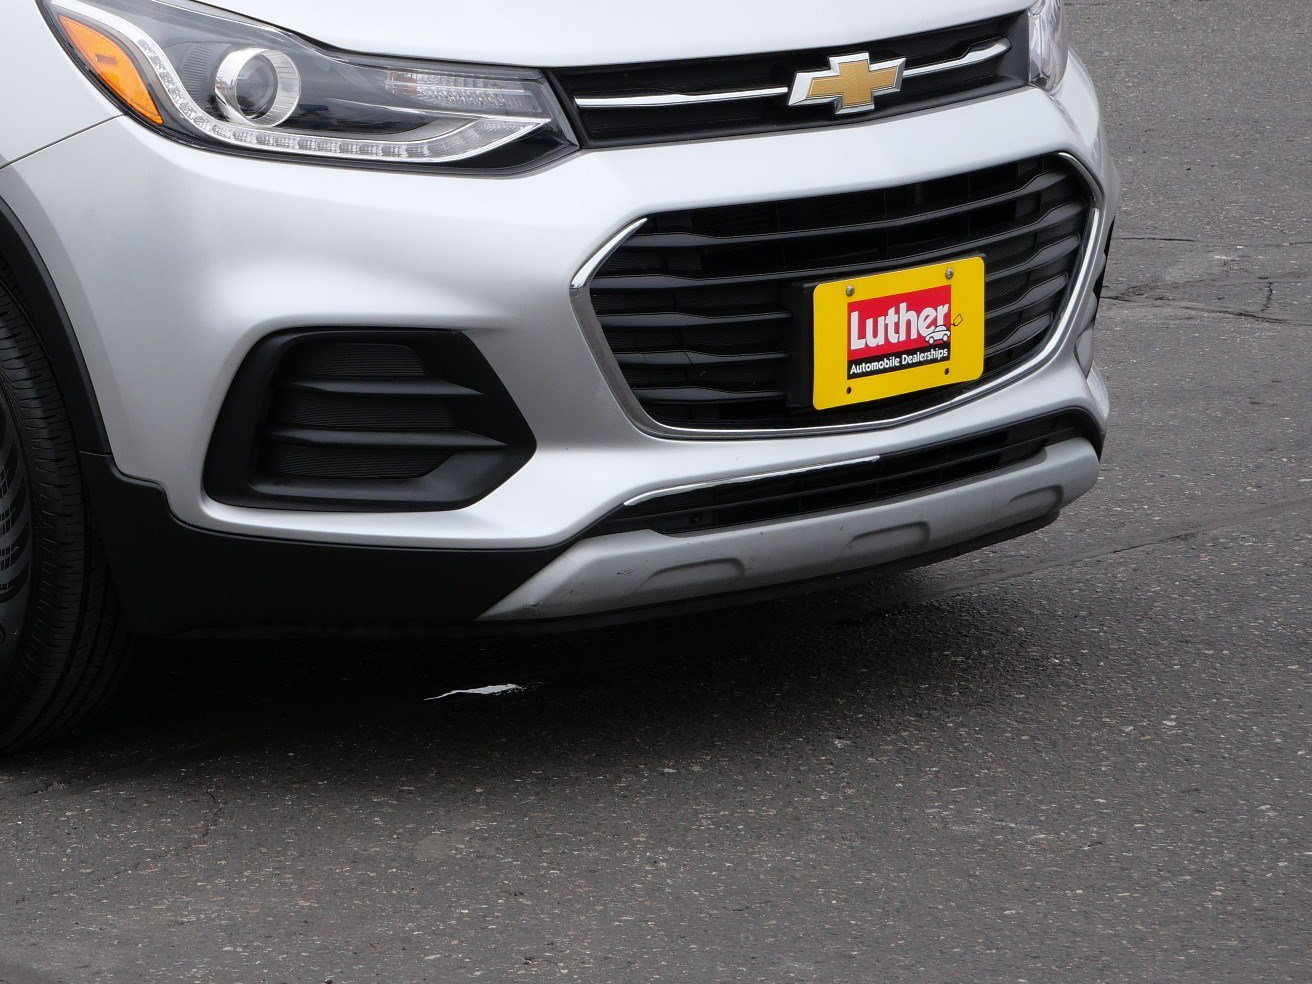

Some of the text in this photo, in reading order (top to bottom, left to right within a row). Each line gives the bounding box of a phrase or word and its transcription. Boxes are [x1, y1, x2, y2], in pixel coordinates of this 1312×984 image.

[850, 301, 950, 350] Luther
[849, 347, 948, 374] Automobile Dealerships
